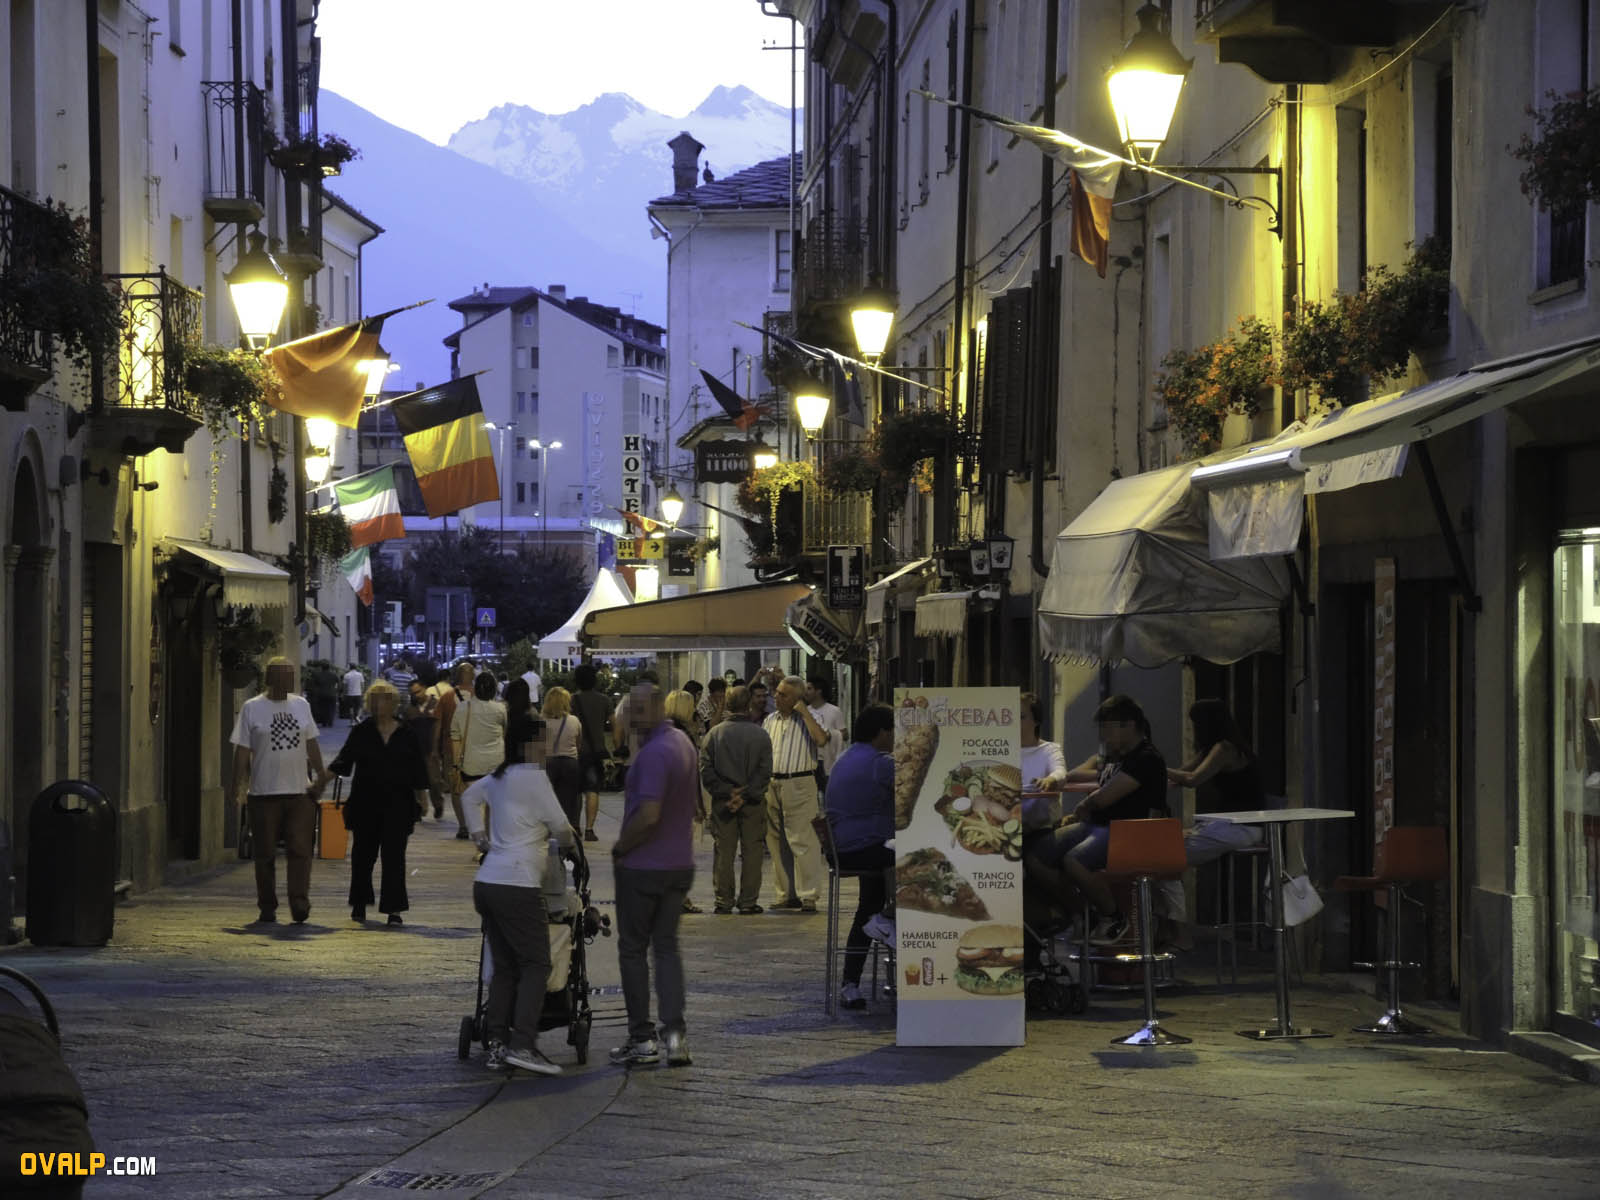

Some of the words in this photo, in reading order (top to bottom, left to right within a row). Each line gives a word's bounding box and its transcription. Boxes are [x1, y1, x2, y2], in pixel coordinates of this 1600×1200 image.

[947, 708, 1013, 727] KEBAB
[962, 738, 1010, 748] FOCACCIA
[981, 748, 1010, 756] KEBAB
[972, 872, 1015, 880] TRANCIO
[978, 881, 988, 889] DI
[988, 881, 1015, 889] PIZZA
[902, 931, 959, 940] HAMBURGER
[902, 940, 937, 949] SPECIAL
